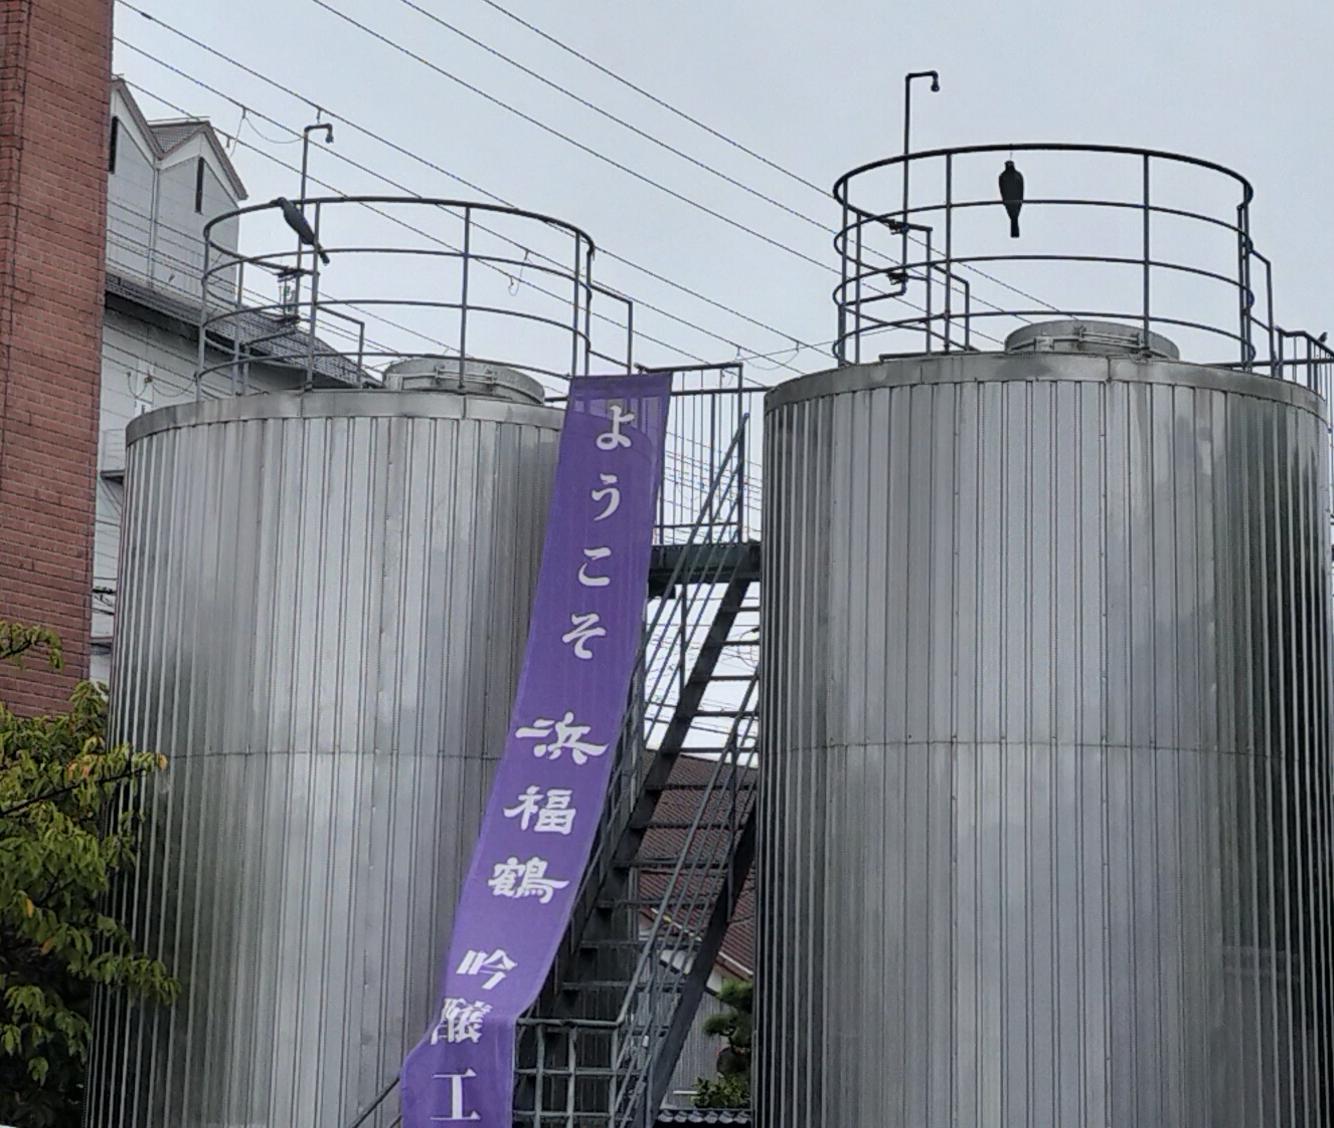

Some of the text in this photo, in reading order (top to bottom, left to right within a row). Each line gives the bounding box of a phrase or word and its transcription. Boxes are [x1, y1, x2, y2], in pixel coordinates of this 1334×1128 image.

[562, 404, 635, 660] ようこそ
[488, 711, 609, 904] 浜福鶴
